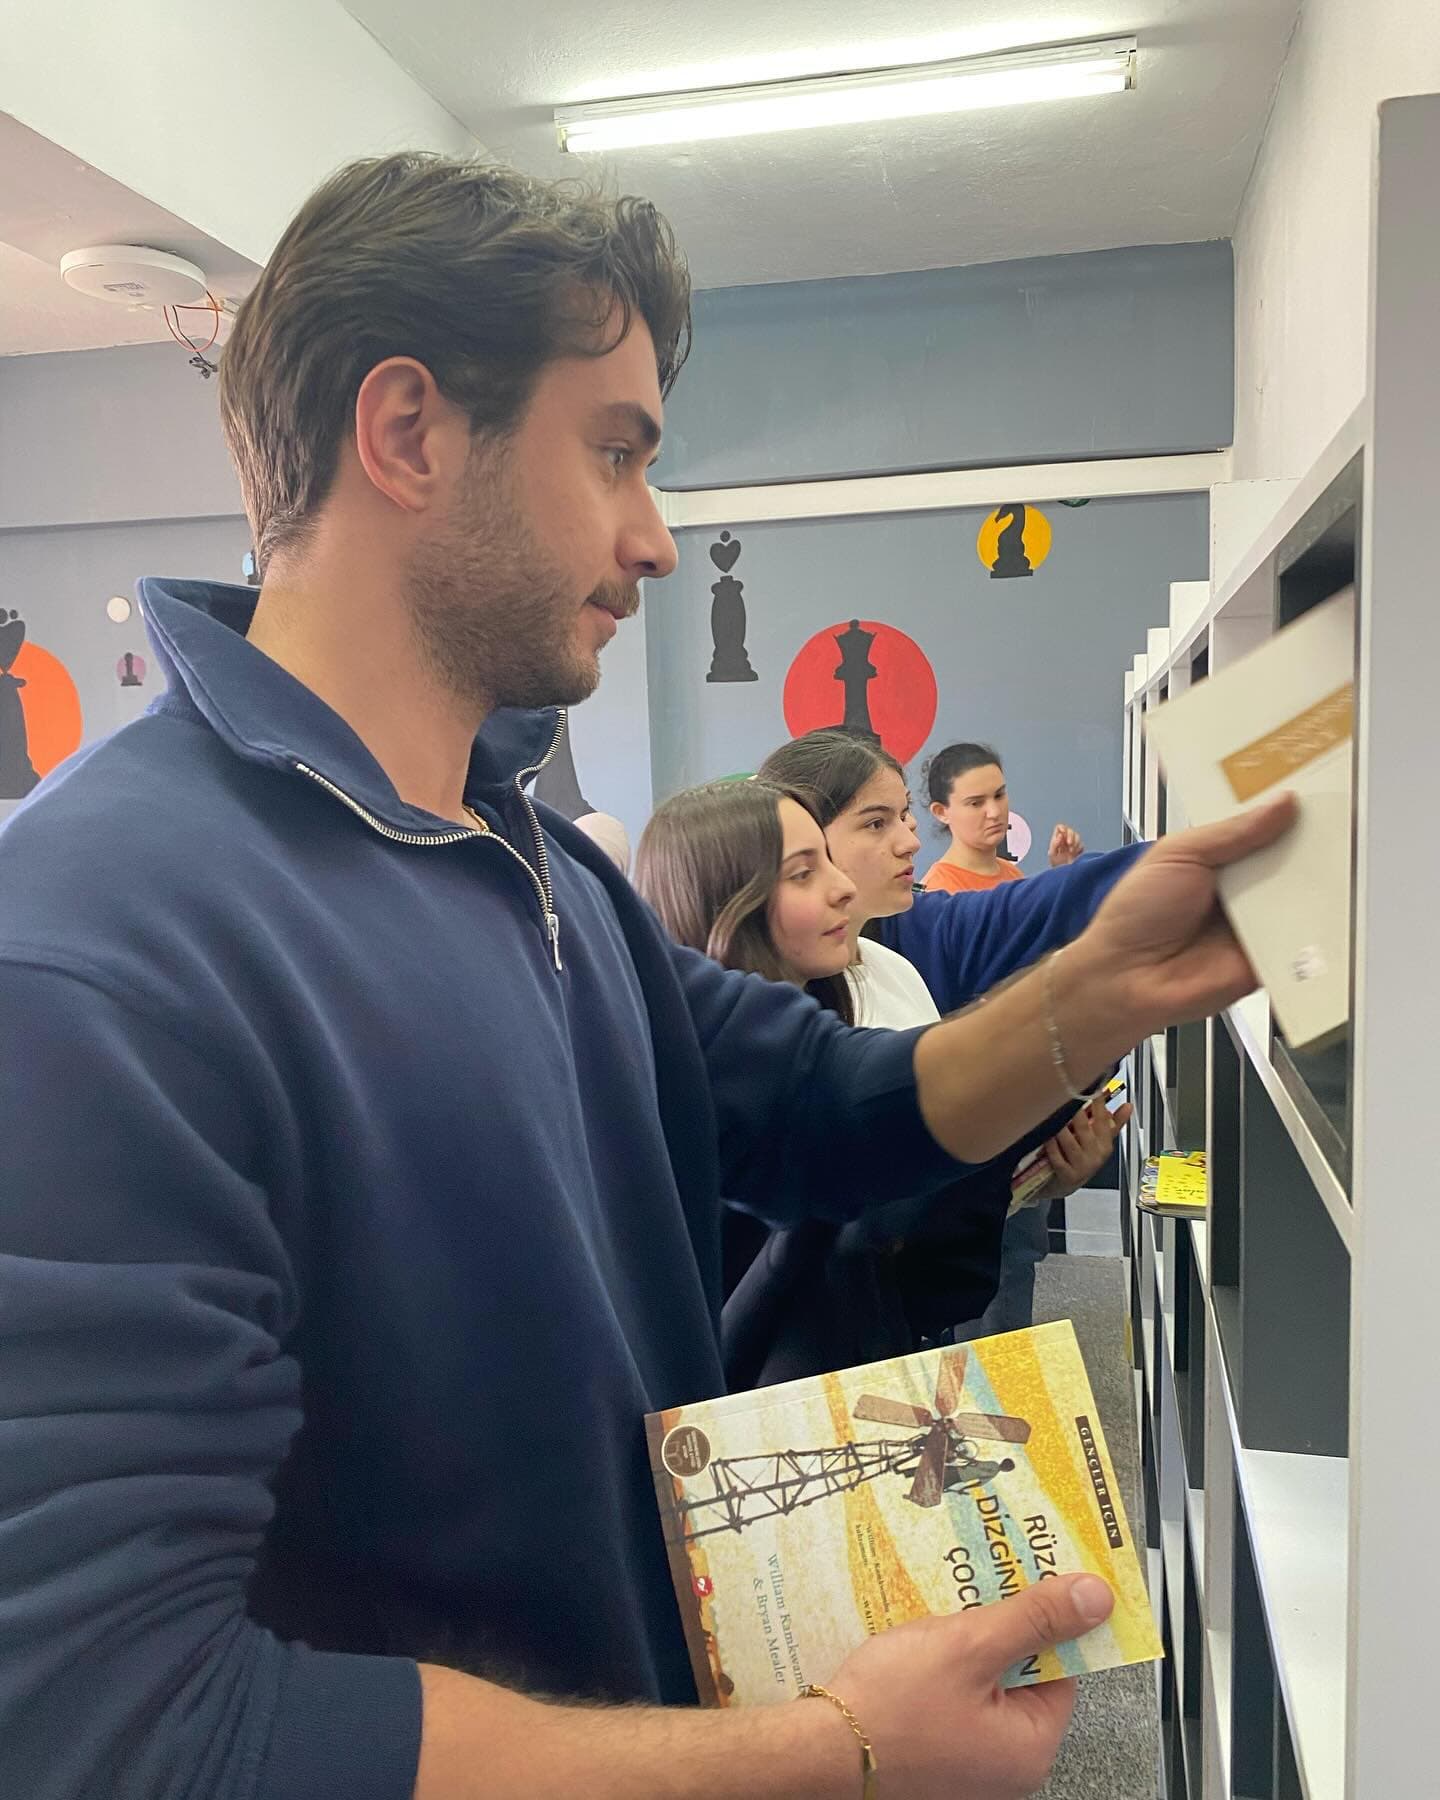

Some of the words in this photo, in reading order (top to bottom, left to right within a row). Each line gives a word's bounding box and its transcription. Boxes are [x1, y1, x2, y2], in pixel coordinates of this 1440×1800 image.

[1080, 1427, 1107, 1496] GENÇLER
[1101, 1503, 1119, 1538] İÇİN
[753, 1577, 764, 1591] &
[757, 1594, 772, 1634] Bryan
[767, 1553, 785, 1609] William
[780, 1614, 810, 1694] Kamkwamb
[767, 1638, 787, 1684] Mealer
